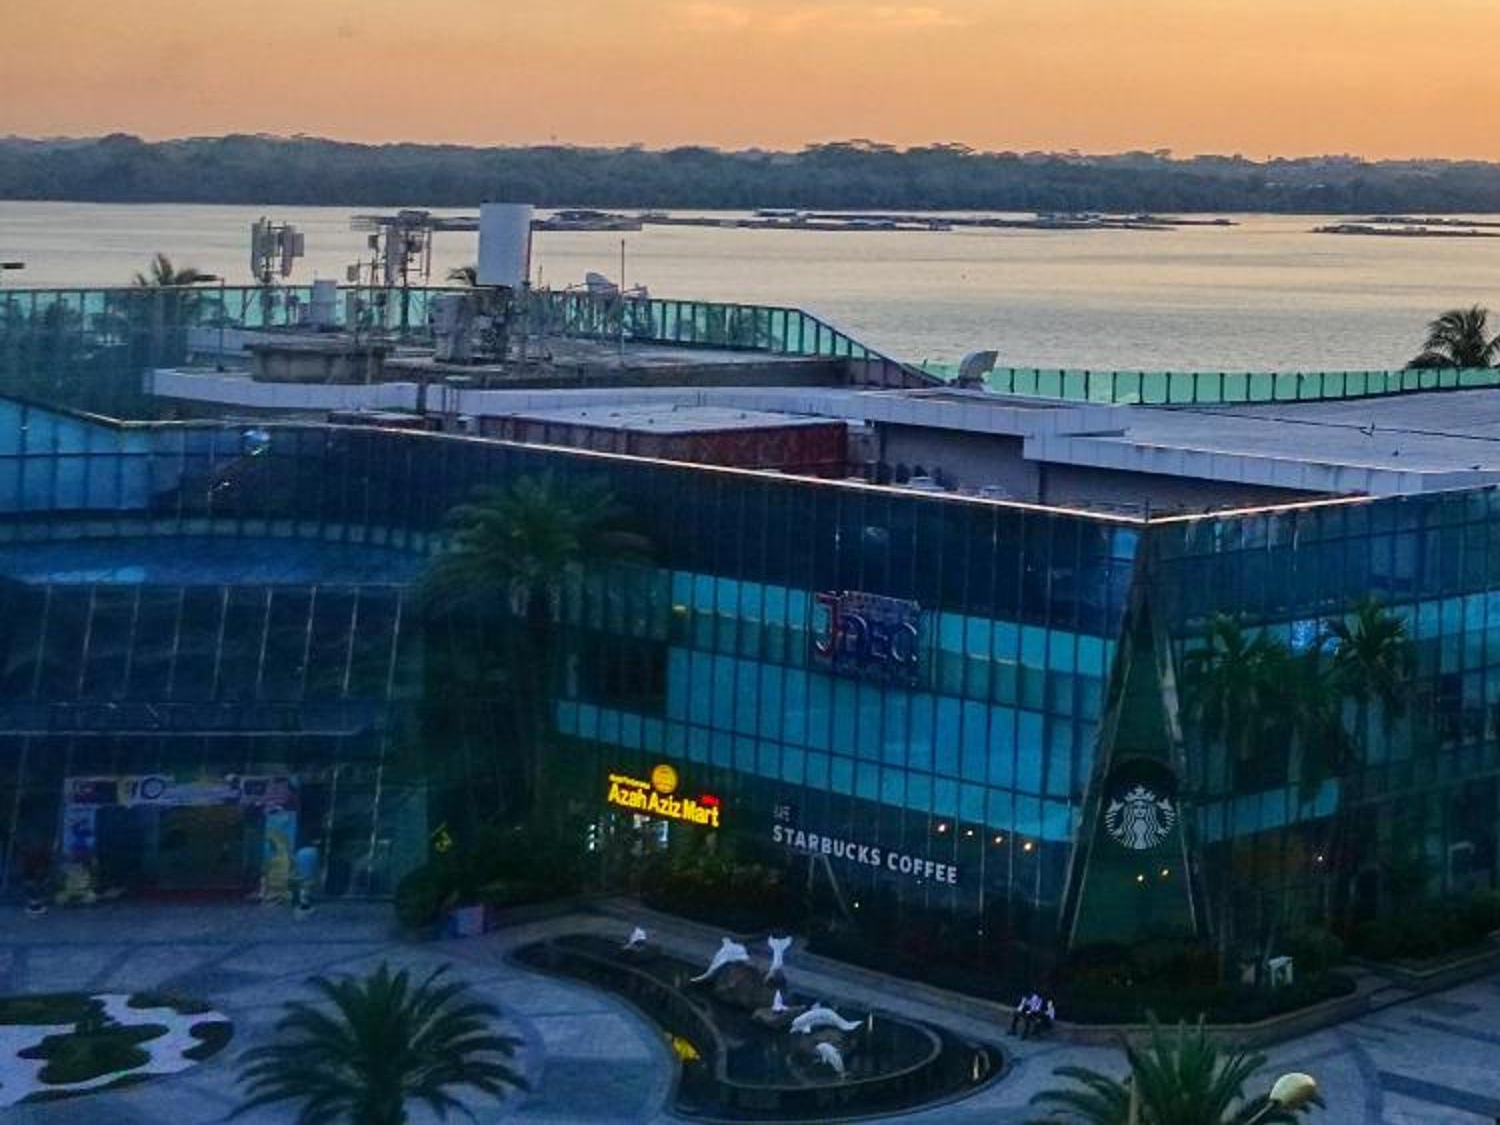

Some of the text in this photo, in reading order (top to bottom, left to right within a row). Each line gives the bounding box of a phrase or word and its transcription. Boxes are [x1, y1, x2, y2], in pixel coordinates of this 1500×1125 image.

[608, 782, 647, 809] Azah
[648, 792, 681, 818] Aziz
[683, 798, 719, 828] Mart
[772, 824, 958, 884] STARBUCKS COFFEE
